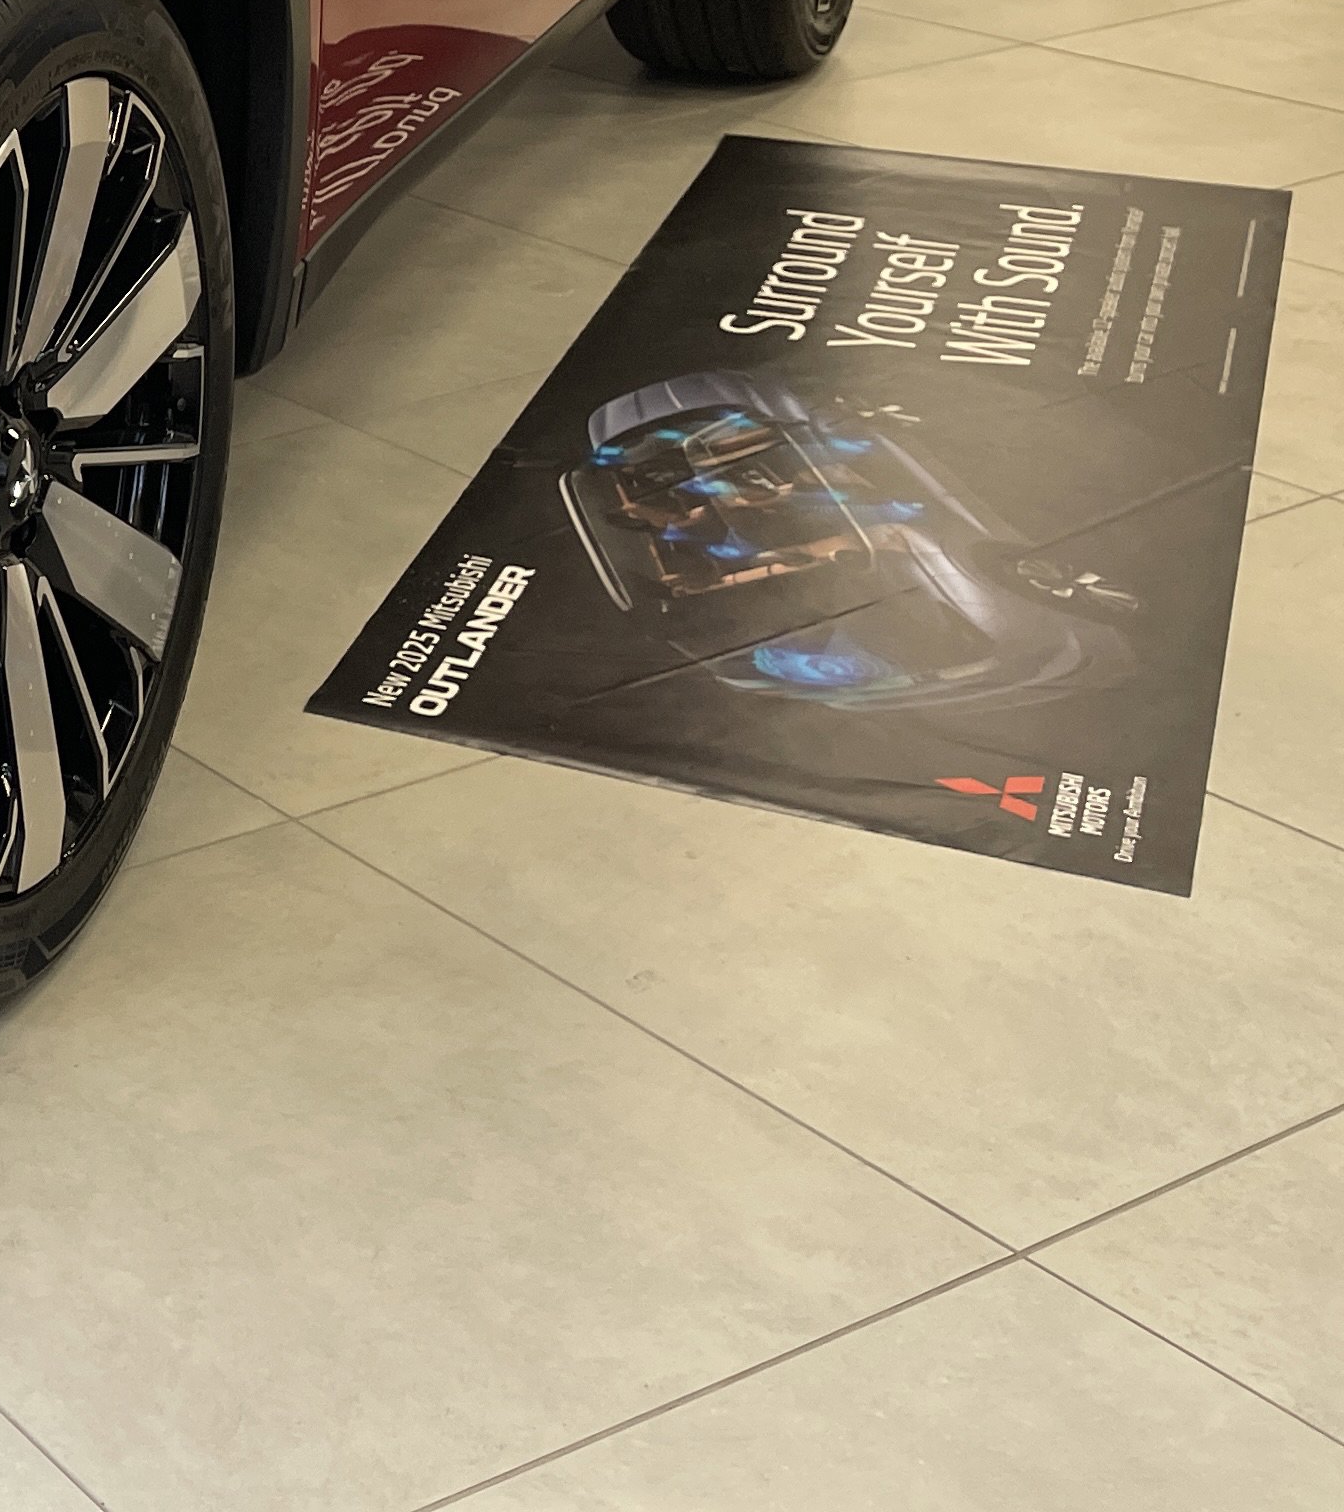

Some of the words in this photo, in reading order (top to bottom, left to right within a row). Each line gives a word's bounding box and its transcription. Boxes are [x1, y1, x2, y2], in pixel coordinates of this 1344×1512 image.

[718, 208, 867, 341] Surround
[826, 230, 961, 349] Yourself
[972, 203, 1085, 294] Sound.
[939, 300, 1052, 367] With
[361, 670, 412, 708] New
[388, 629, 441, 673] 2025
[417, 553, 494, 631] Mitsubishi
[408, 565, 537, 717] OUTLANDER
[1047, 771, 1085, 838] MITSUBISHI
[1079, 786, 1112, 837] MOTORS
